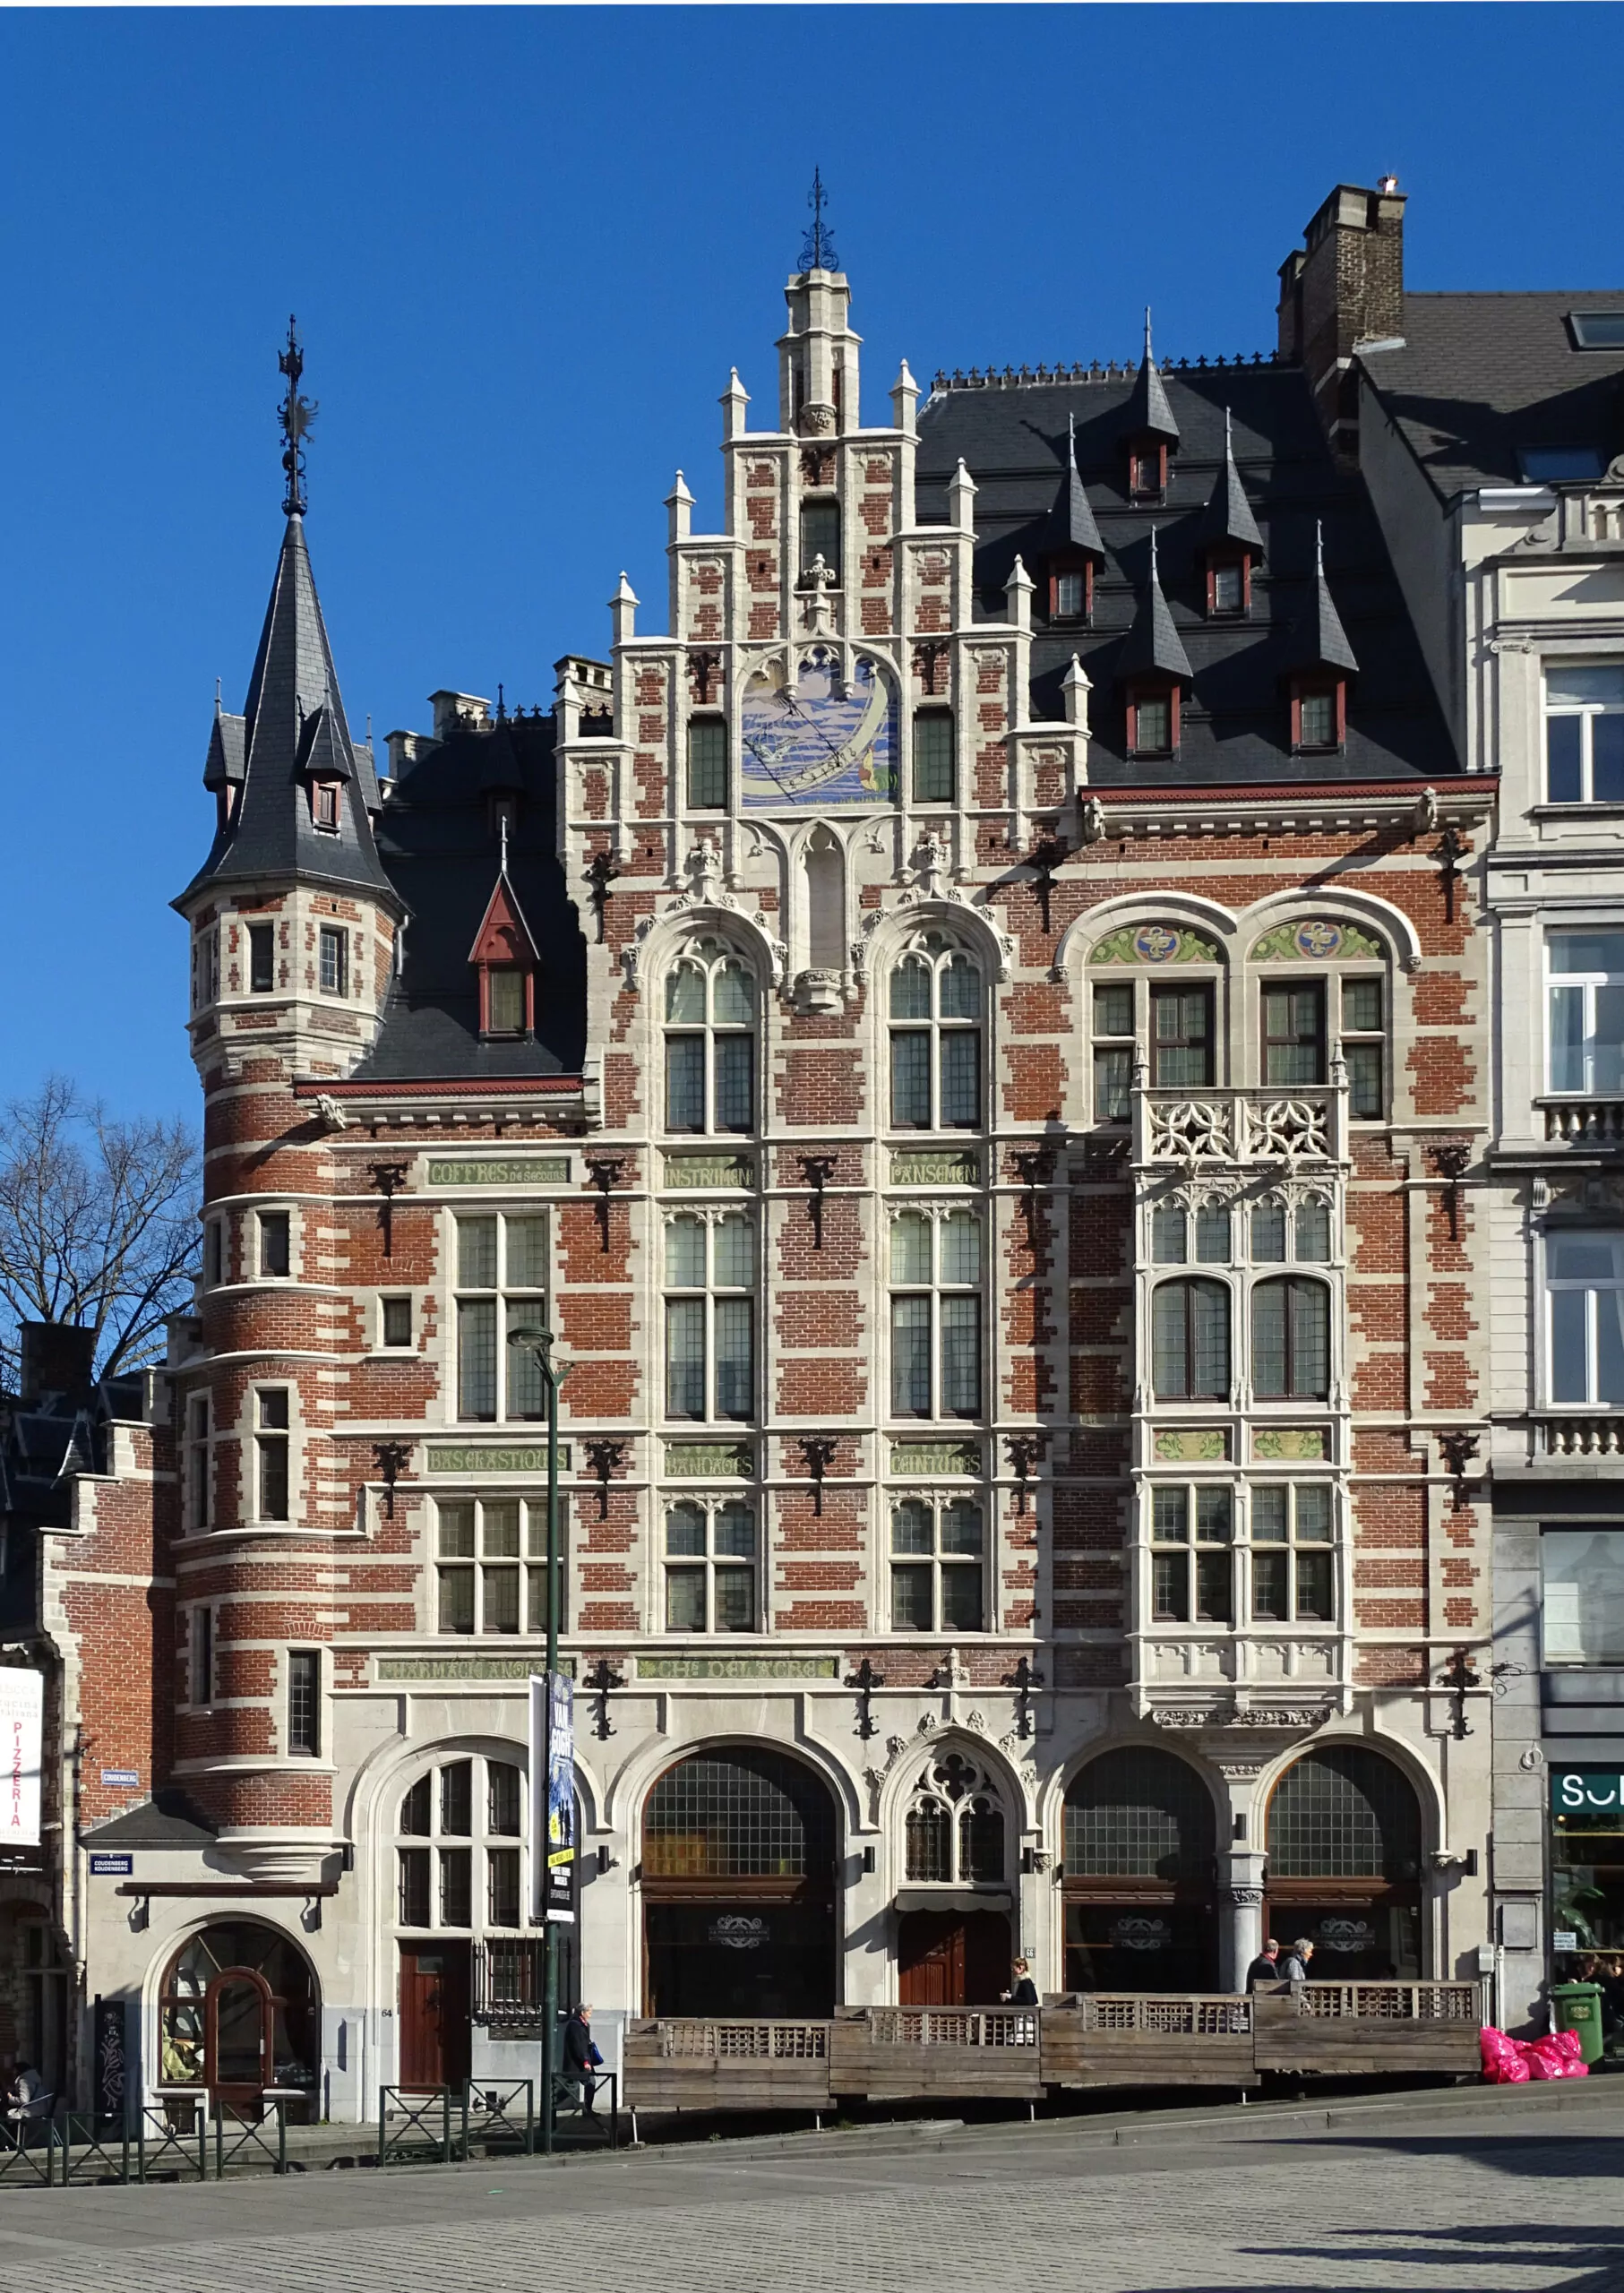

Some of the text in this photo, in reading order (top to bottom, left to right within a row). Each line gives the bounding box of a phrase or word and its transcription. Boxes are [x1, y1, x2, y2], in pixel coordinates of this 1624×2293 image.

[431, 1163, 508, 1183] COFFRES
[429, 1449, 567, 1470] BAS ELASTIQUS
[666, 1456, 752, 1475] BANDAGES
[890, 1454, 981, 1473] CEINTURES
[554, 1702, 568, 1729] VAN
[552, 1728, 571, 1757] GOGH
[11, 1722, 22, 1826] PIZZERIA
[103, 1773, 137, 1782] COUDENBERG
[381, 2009, 392, 2017] 64
